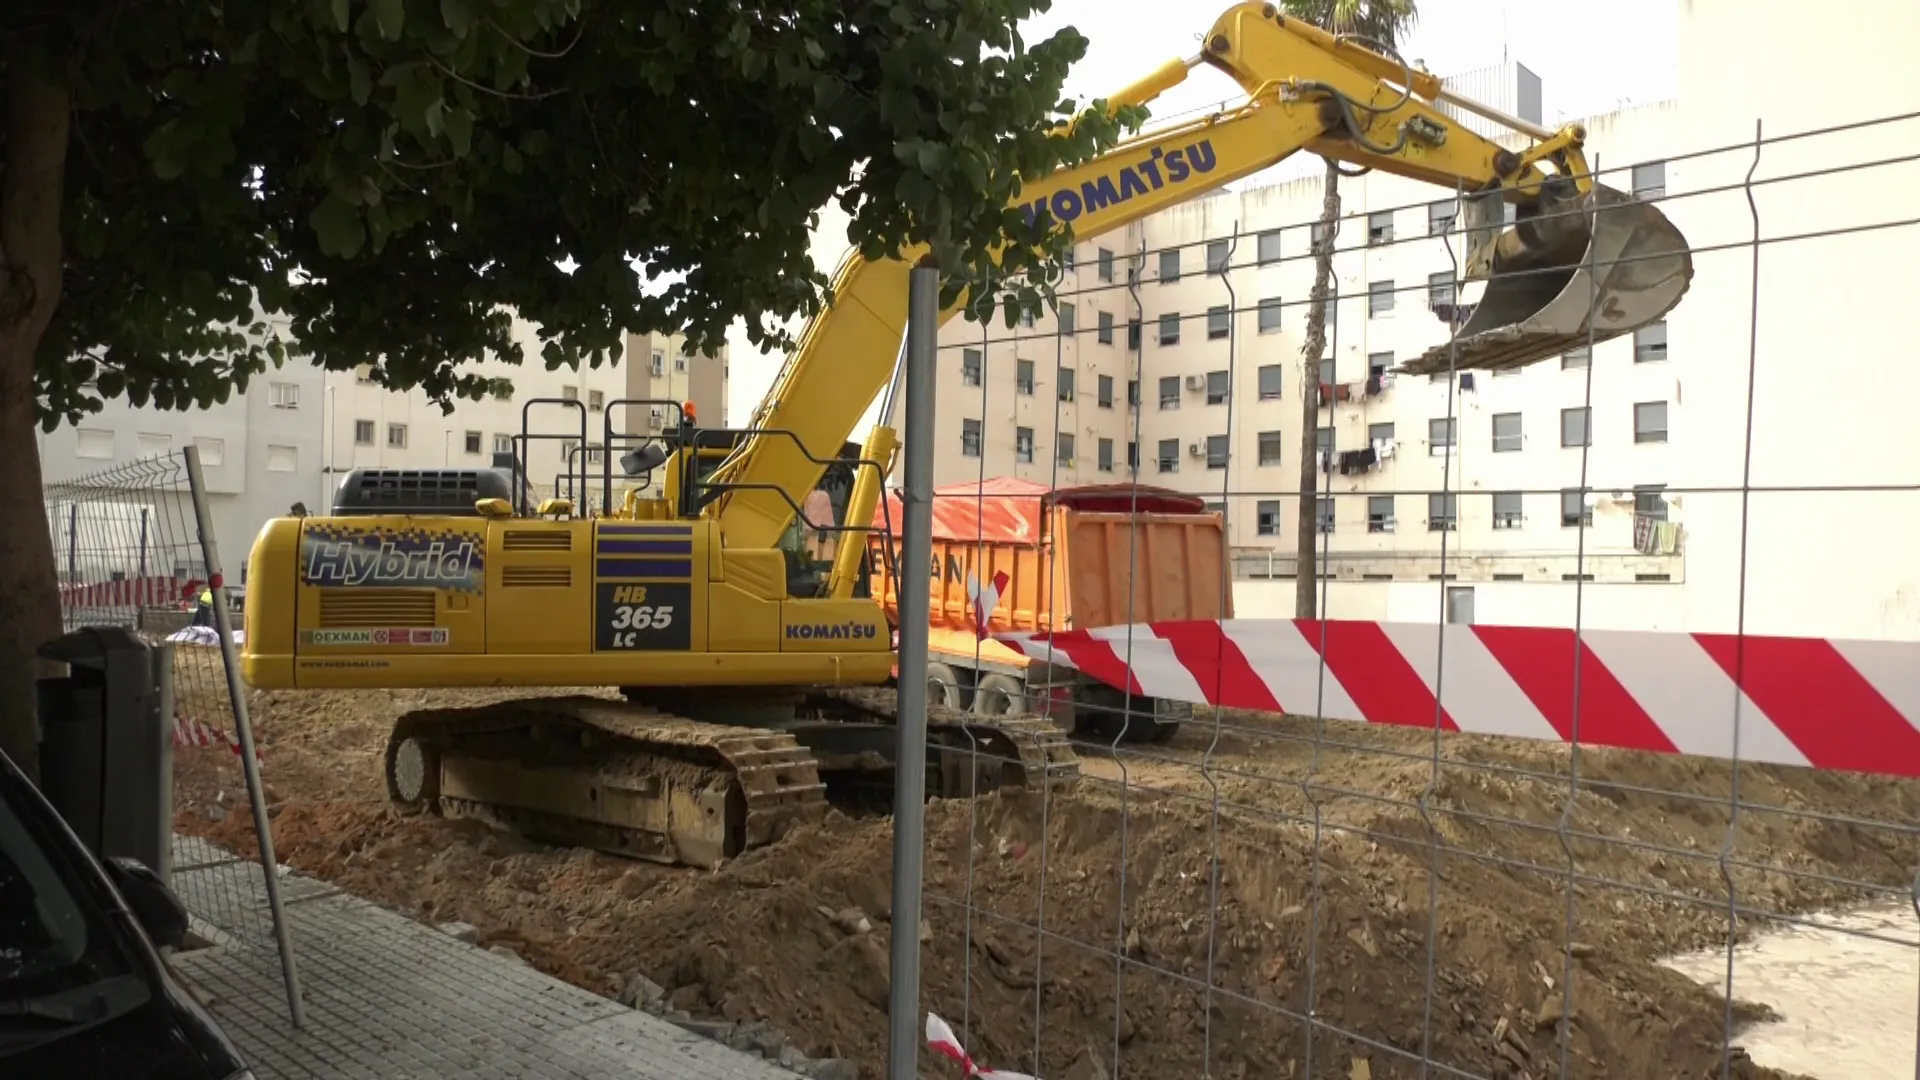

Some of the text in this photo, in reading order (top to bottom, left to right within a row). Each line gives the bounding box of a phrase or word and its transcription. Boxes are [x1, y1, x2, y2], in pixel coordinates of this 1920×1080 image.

[1017, 139, 1217, 228] KOMATSU
[307, 541, 474, 585] Hybrid
[612, 586, 647, 603] HB
[611, 606, 674, 630] 365
[612, 632, 637, 647] LC
[785, 621, 876, 639] KOMATSU
